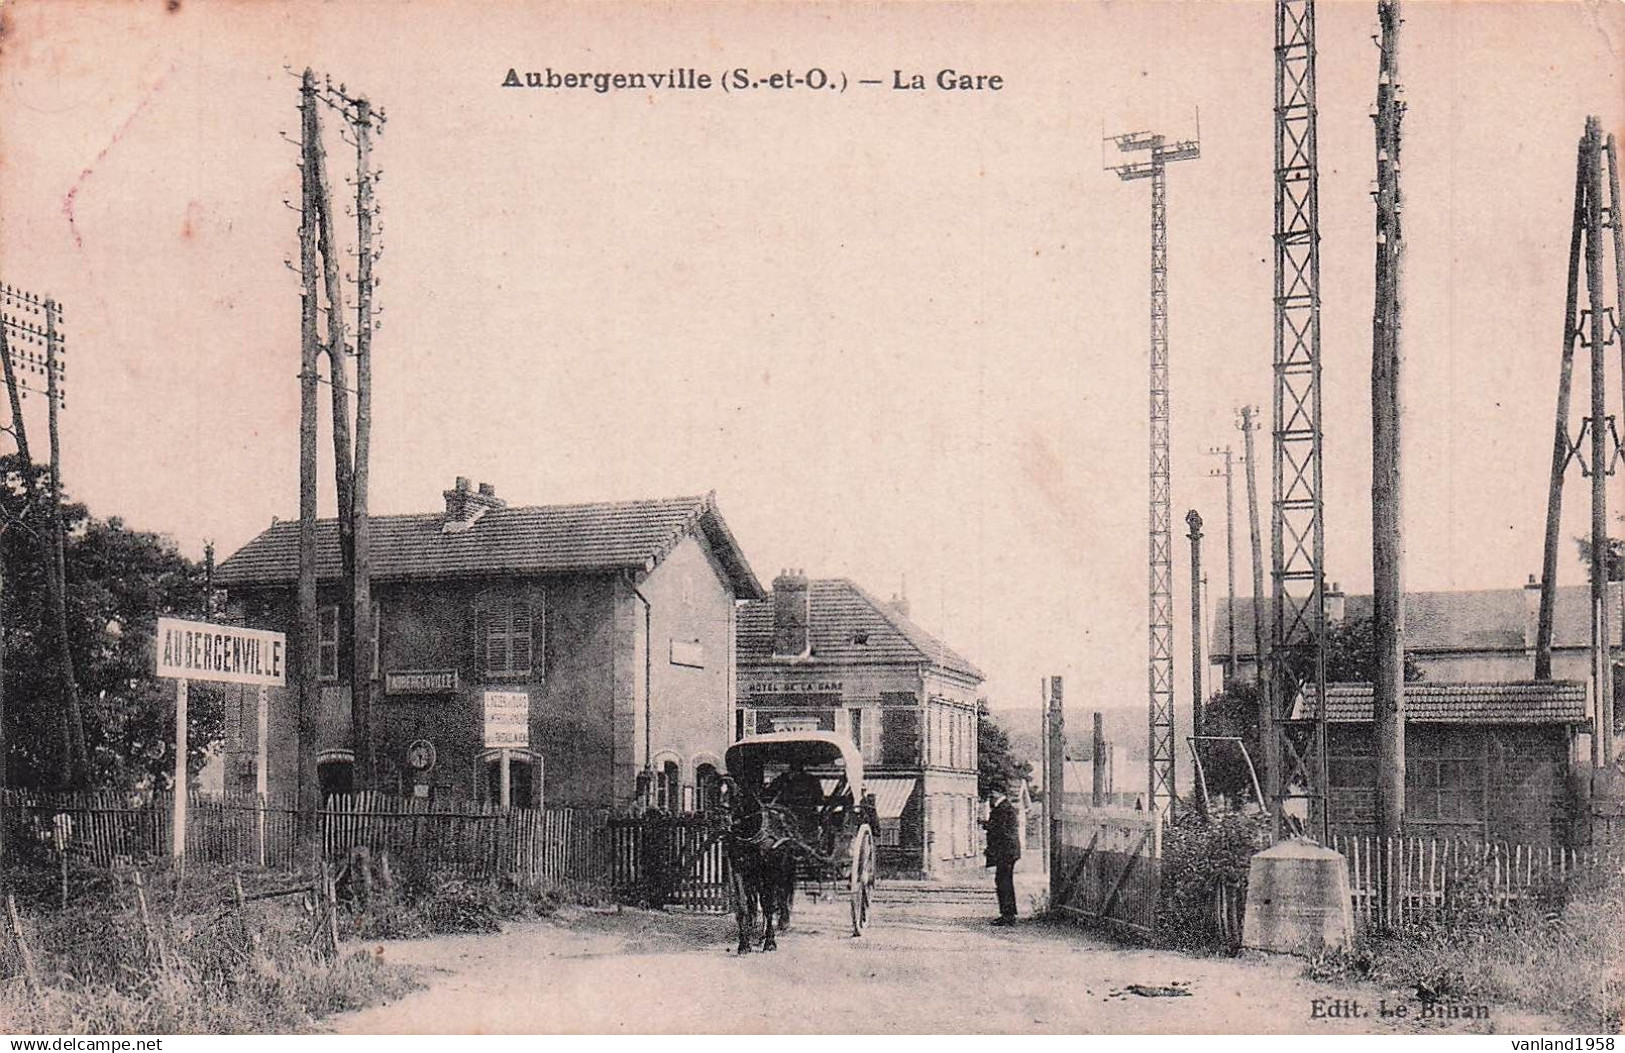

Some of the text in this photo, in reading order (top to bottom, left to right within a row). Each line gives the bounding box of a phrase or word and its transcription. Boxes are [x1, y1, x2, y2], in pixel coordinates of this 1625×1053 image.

[162, 629, 281, 677] AUBERGENVILLE
[784, 682, 798, 692] DE
[800, 682, 814, 692] LA
[818, 682, 843, 691] GARE
